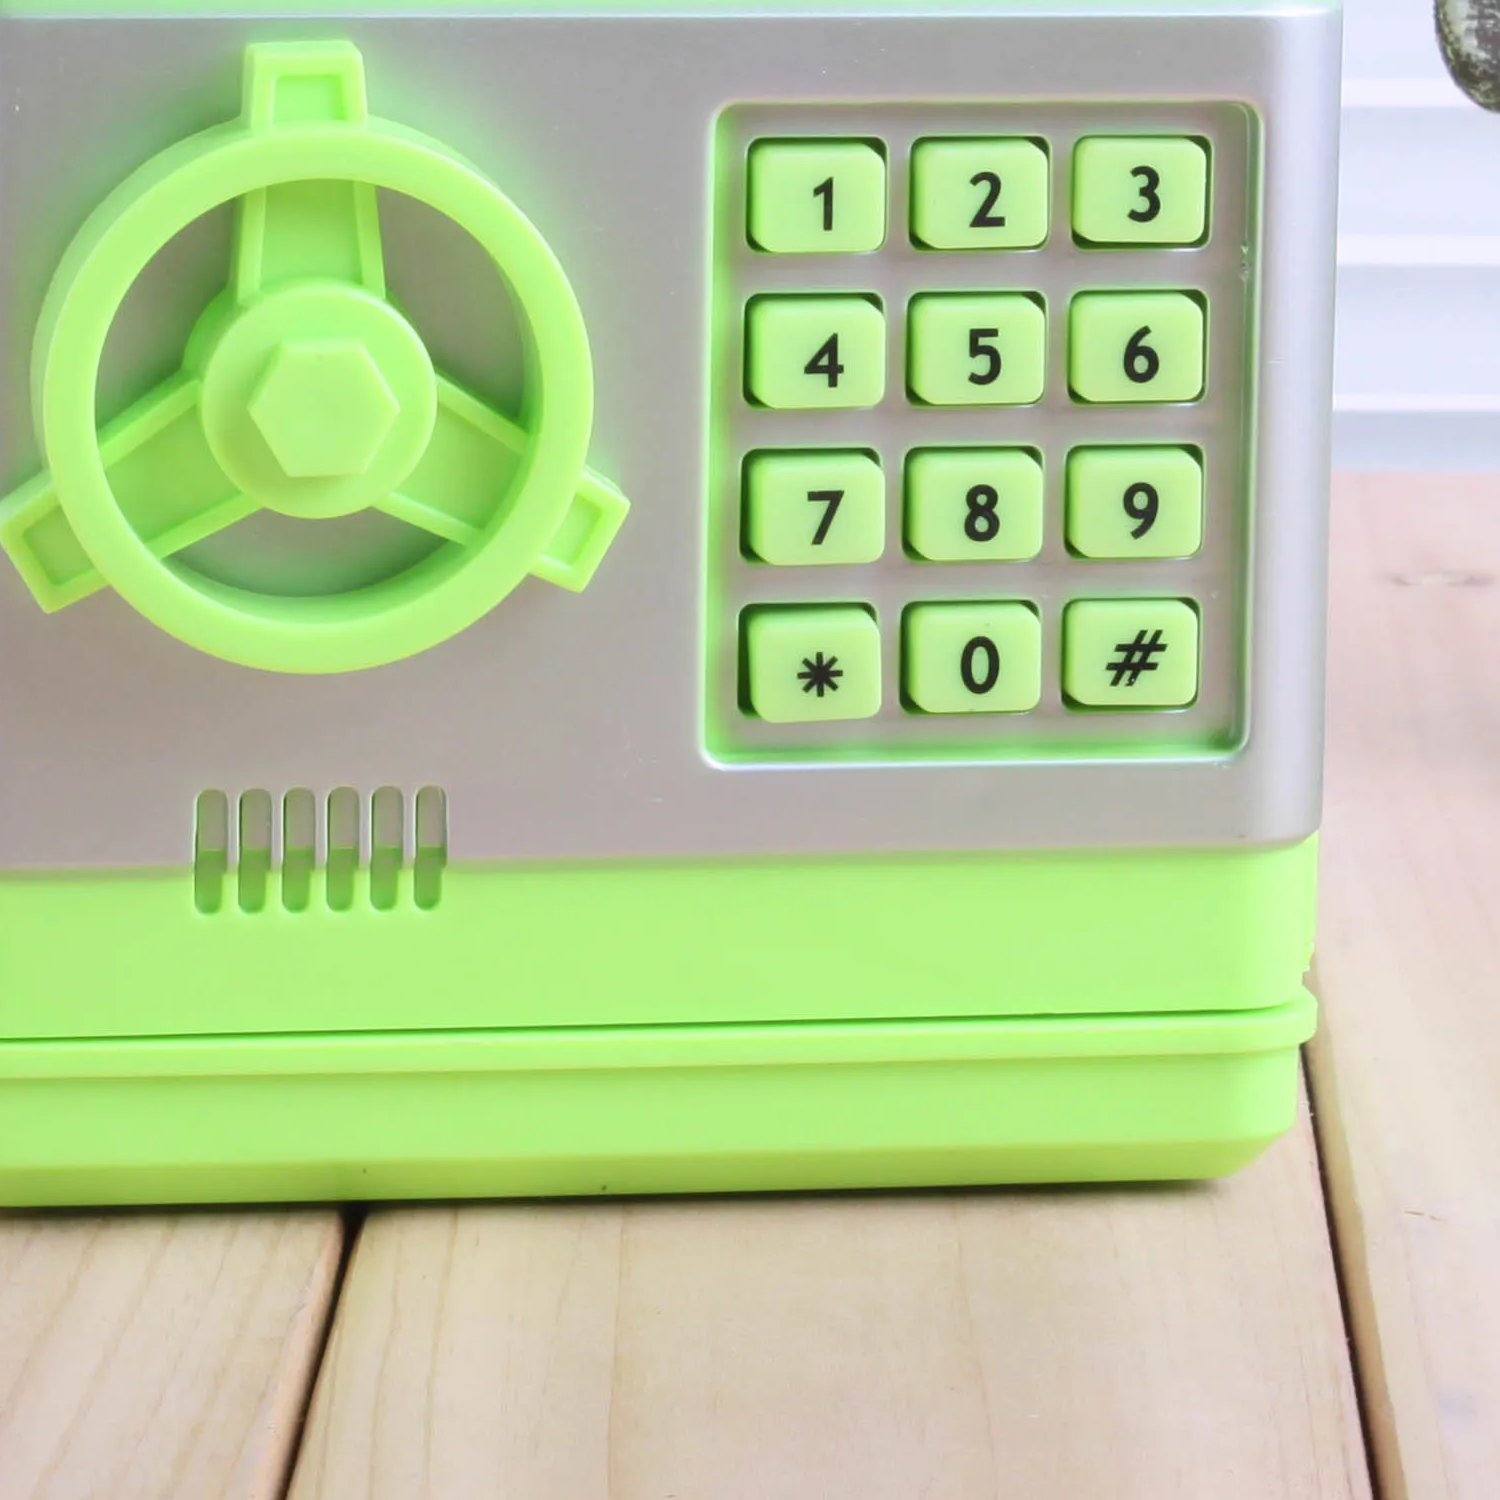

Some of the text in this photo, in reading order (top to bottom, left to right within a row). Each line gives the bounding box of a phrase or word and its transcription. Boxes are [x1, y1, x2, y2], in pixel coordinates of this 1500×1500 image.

[813, 166, 1161, 232] 1 2 3
[804, 326, 1160, 389] 4 5 6
[807, 481, 1160, 546] 7 8 9
[959, 635, 1000, 695] 0
